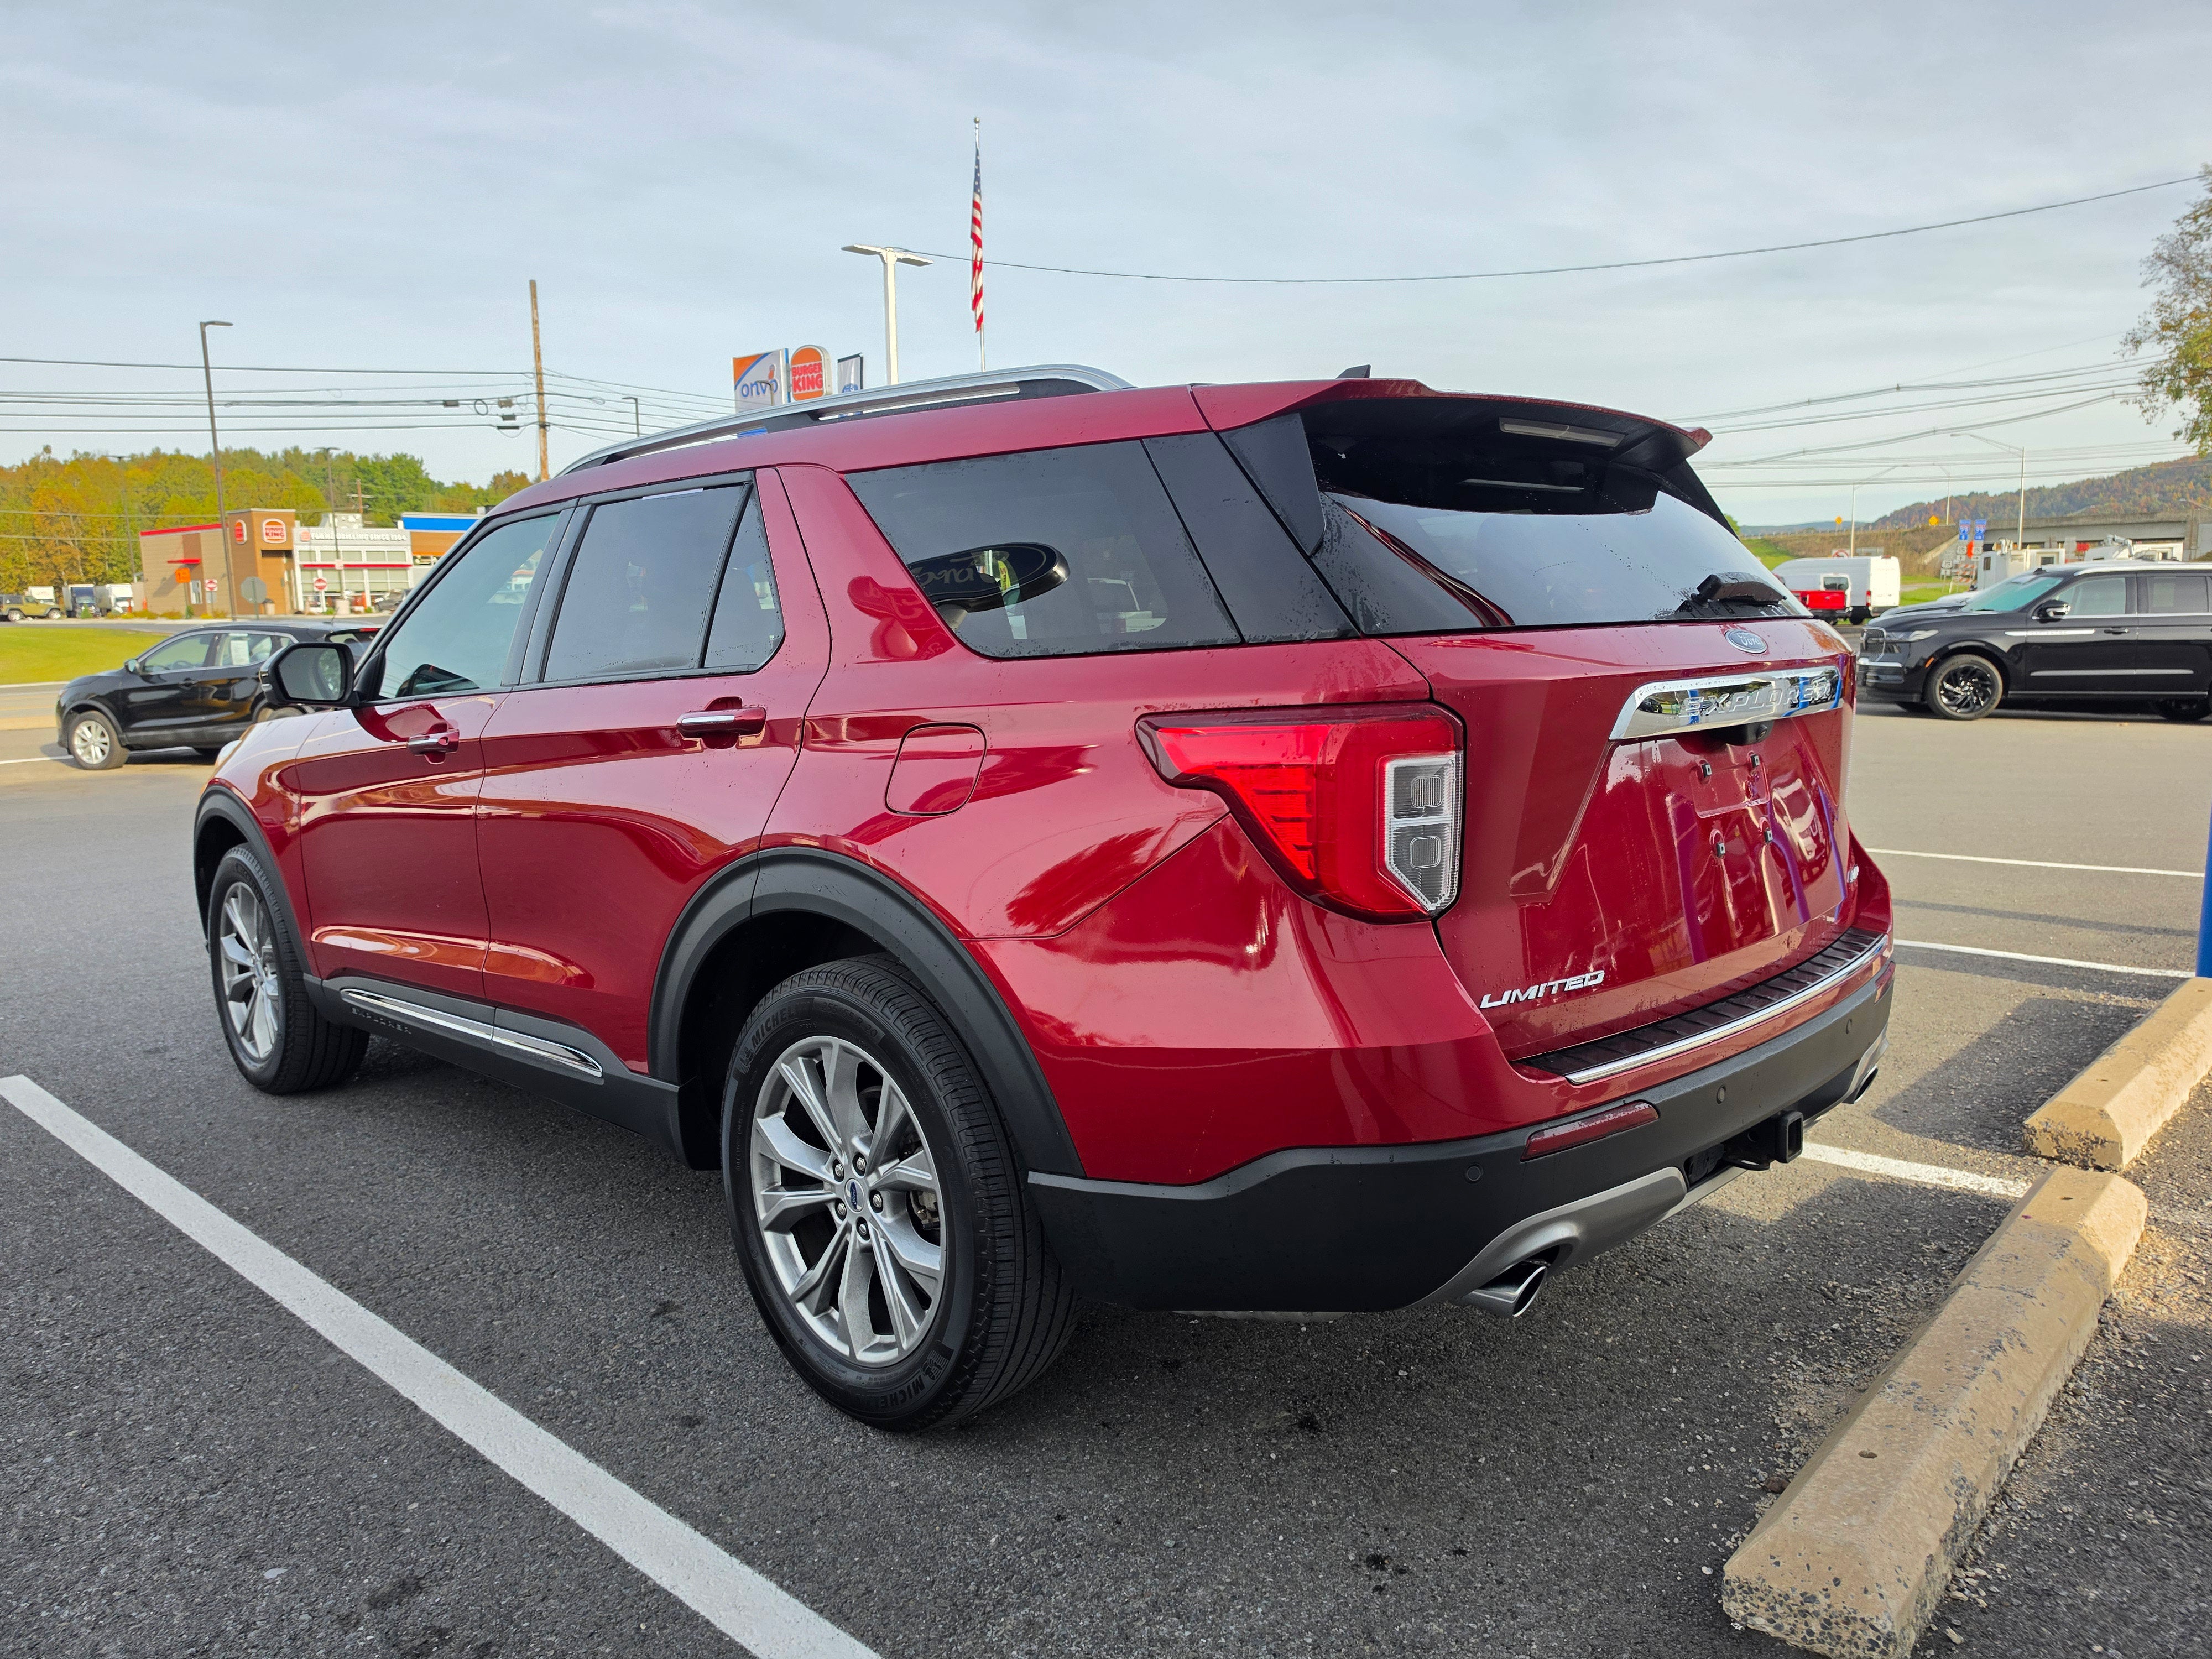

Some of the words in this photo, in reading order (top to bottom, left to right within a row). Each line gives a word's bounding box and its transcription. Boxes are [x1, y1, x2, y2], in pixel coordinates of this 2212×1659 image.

[791, 362, 823, 377] BURGER
[792, 374, 823, 393] KING
[1736, 632, 1763, 646] Ford
[1678, 683, 1830, 718] EXPLORER
[1479, 969, 1605, 1009] LIMITED
[864, 1024, 878, 1038] 20
